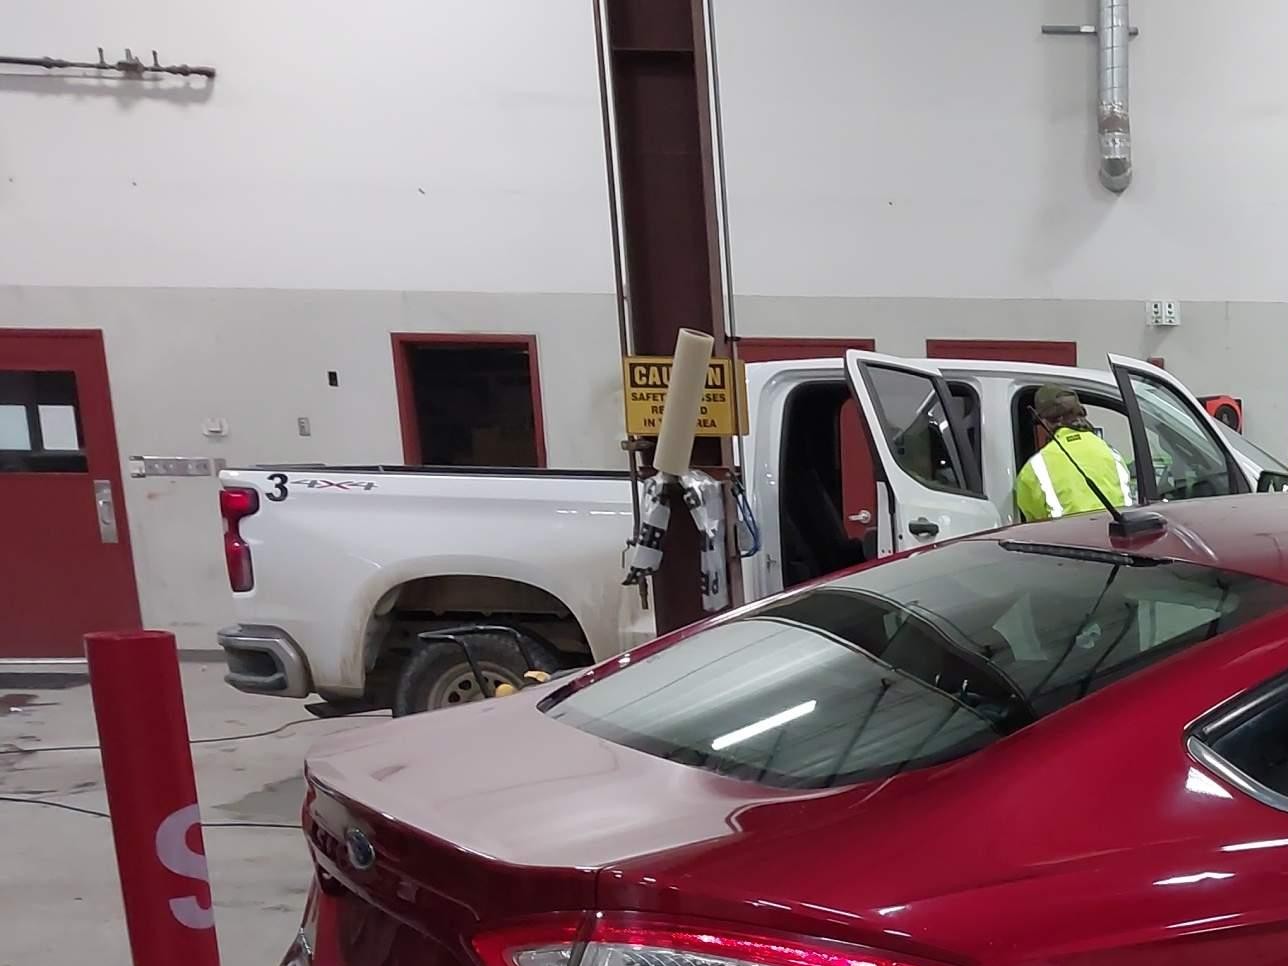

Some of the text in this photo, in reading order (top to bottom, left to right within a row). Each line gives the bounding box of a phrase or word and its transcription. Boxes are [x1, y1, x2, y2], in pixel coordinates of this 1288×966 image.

[633, 366, 721, 387] CAUN
[631, 392, 665, 402] SAFET
[644, 418, 656, 428] IN
[264, 473, 289, 502] 3
[155, 802, 216, 930] S
